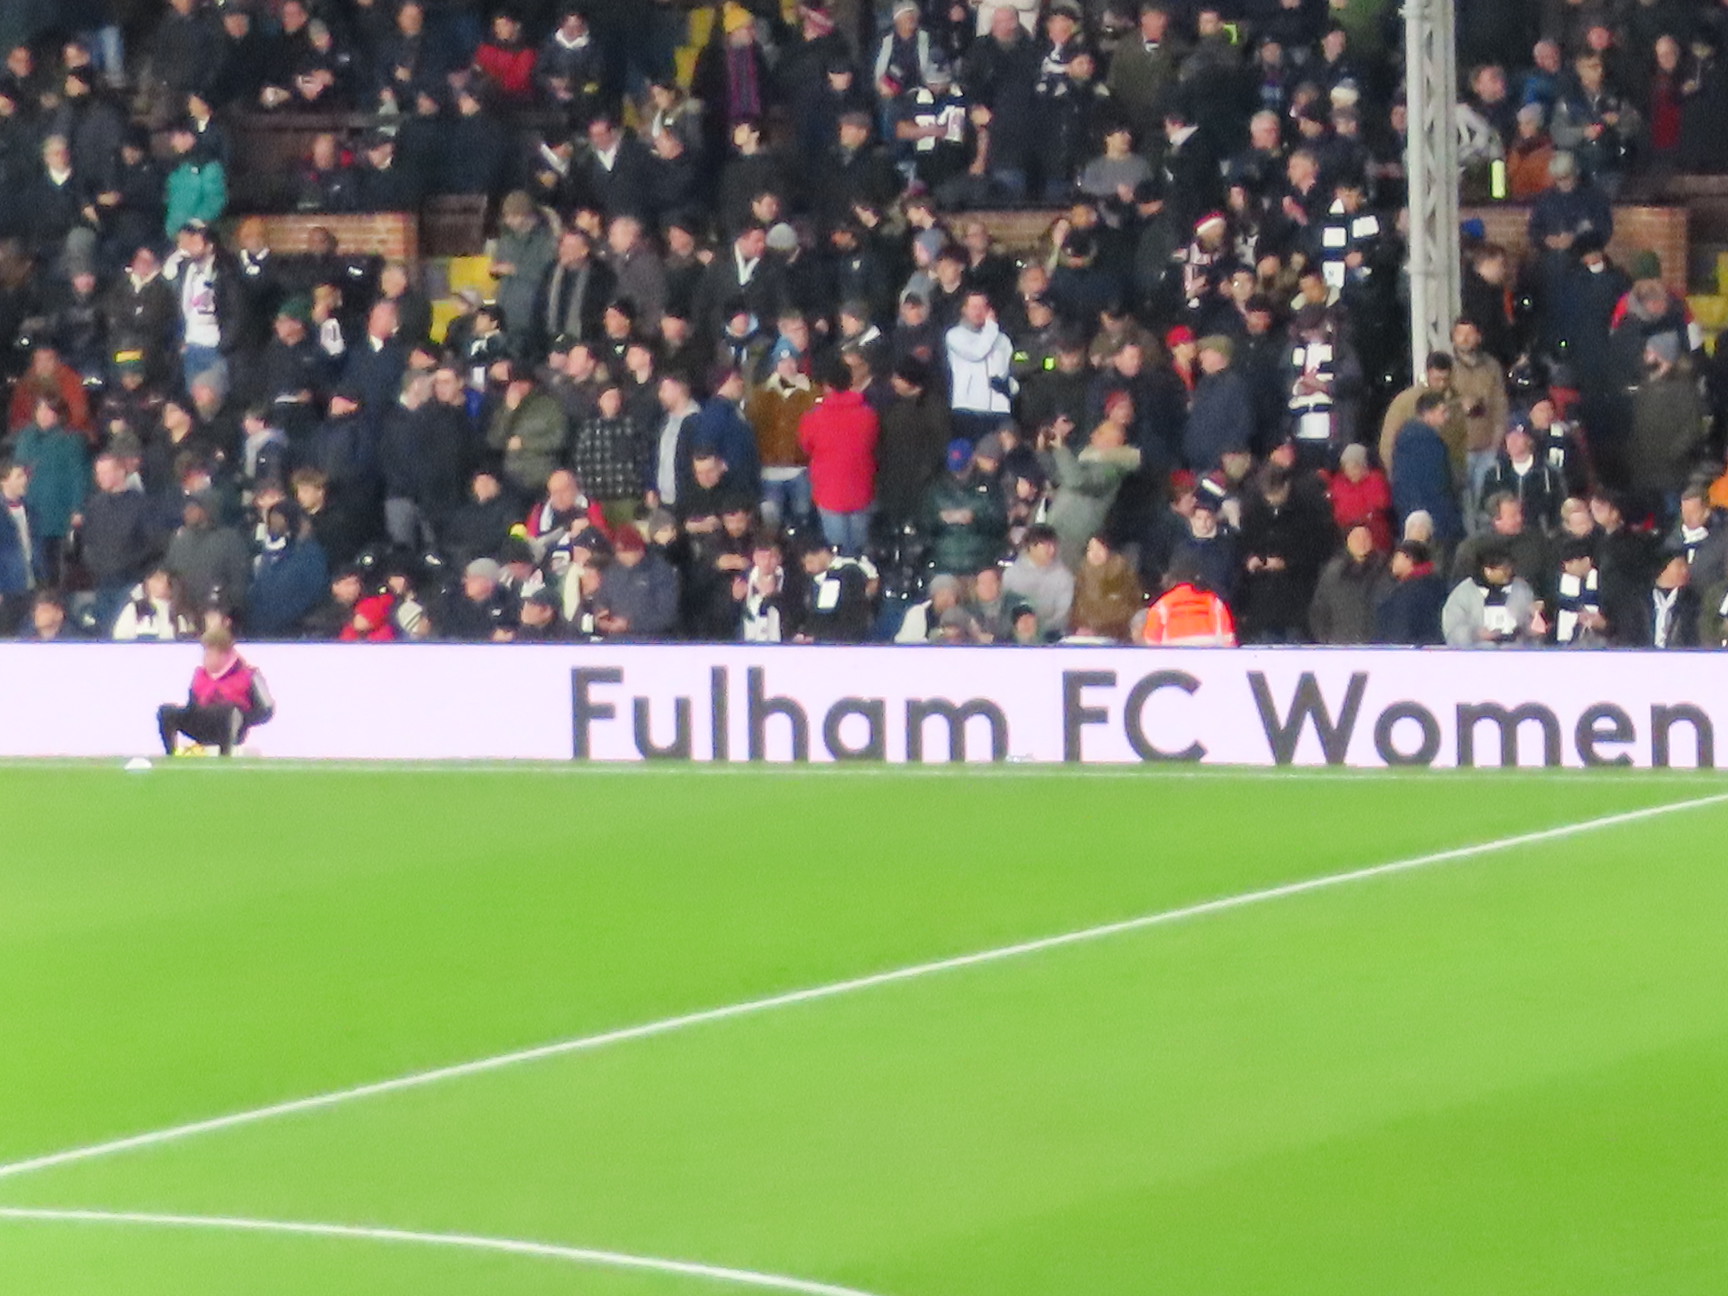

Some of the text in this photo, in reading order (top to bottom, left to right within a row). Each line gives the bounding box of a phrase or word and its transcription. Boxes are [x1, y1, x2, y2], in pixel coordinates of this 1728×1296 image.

[571, 665, 1714, 768] Fulham FC Women
